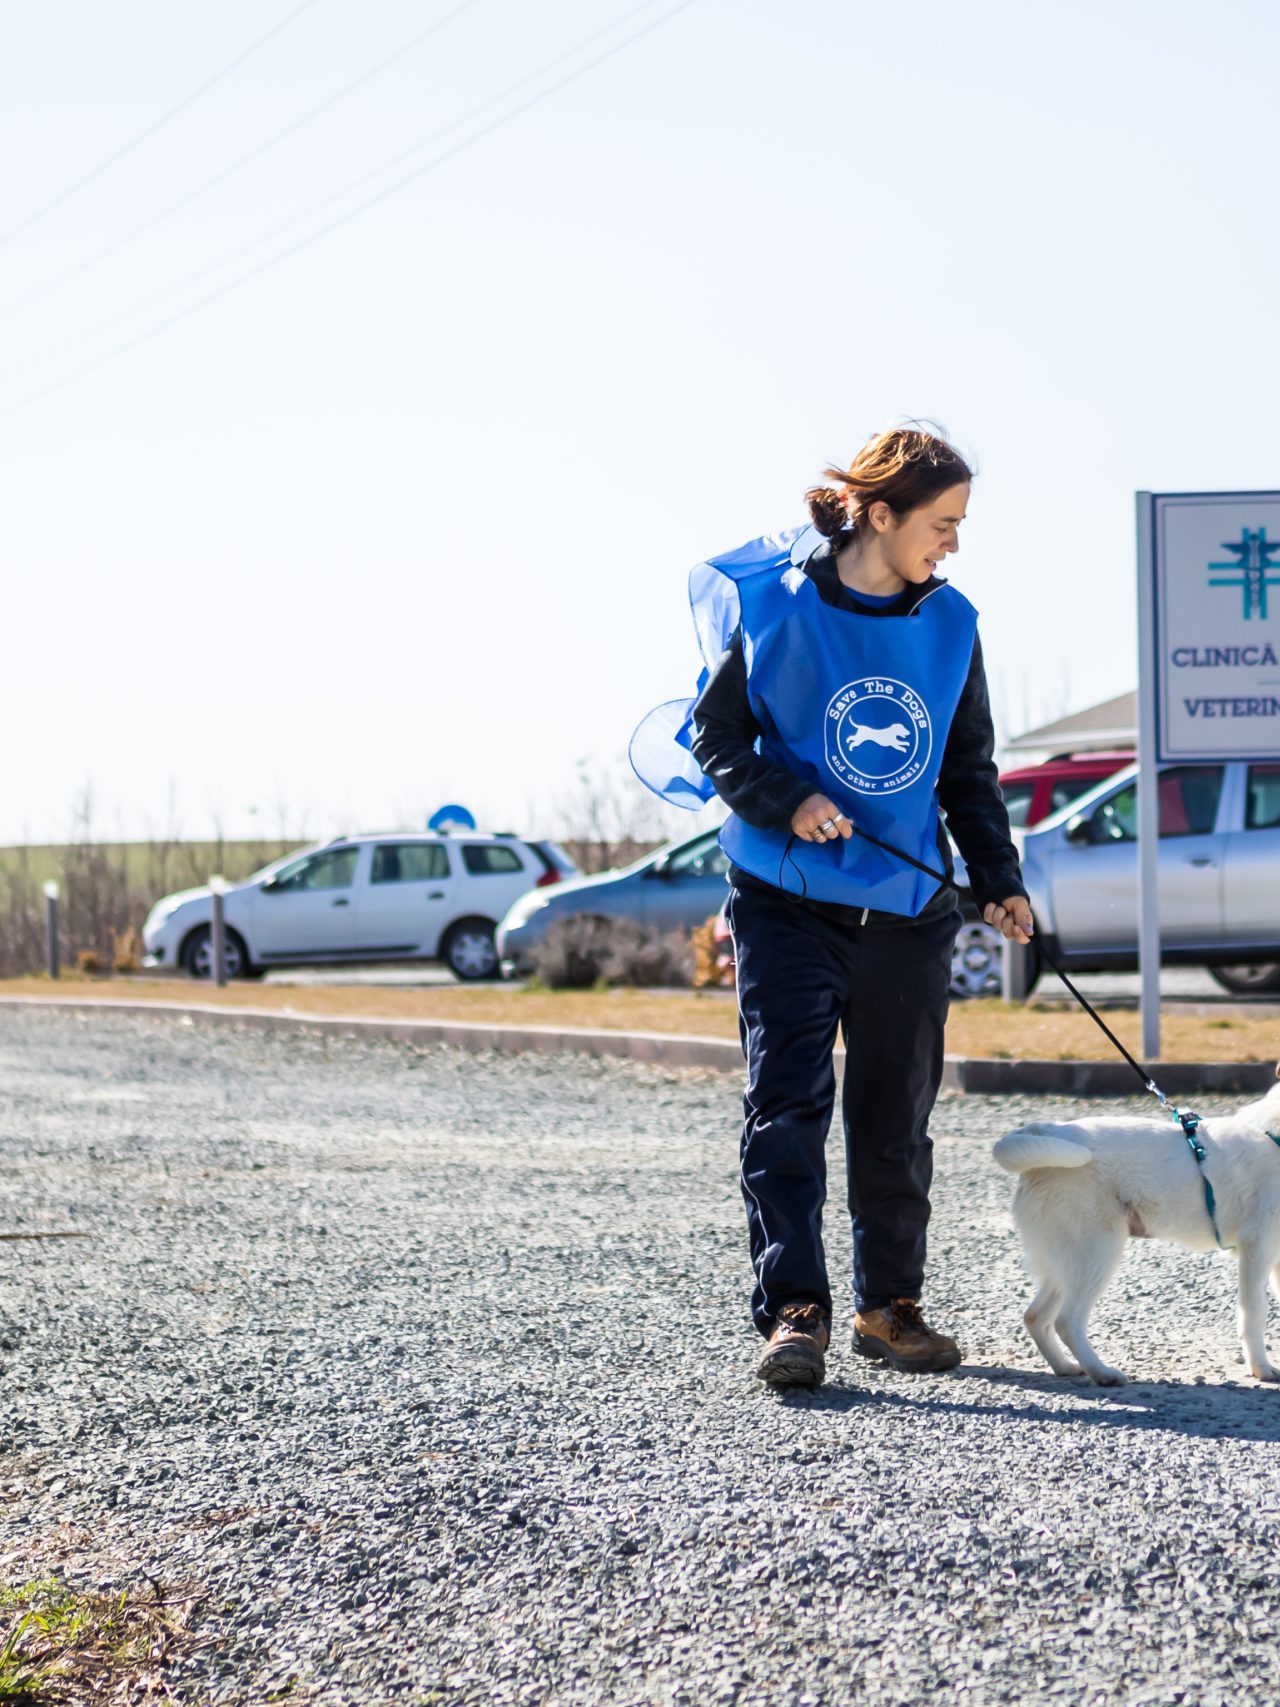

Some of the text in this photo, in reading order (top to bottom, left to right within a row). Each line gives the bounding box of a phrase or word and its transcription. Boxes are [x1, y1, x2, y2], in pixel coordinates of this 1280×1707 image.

[829, 681, 927, 729] Save The Dogs
[831, 754, 921, 789] and other animals
